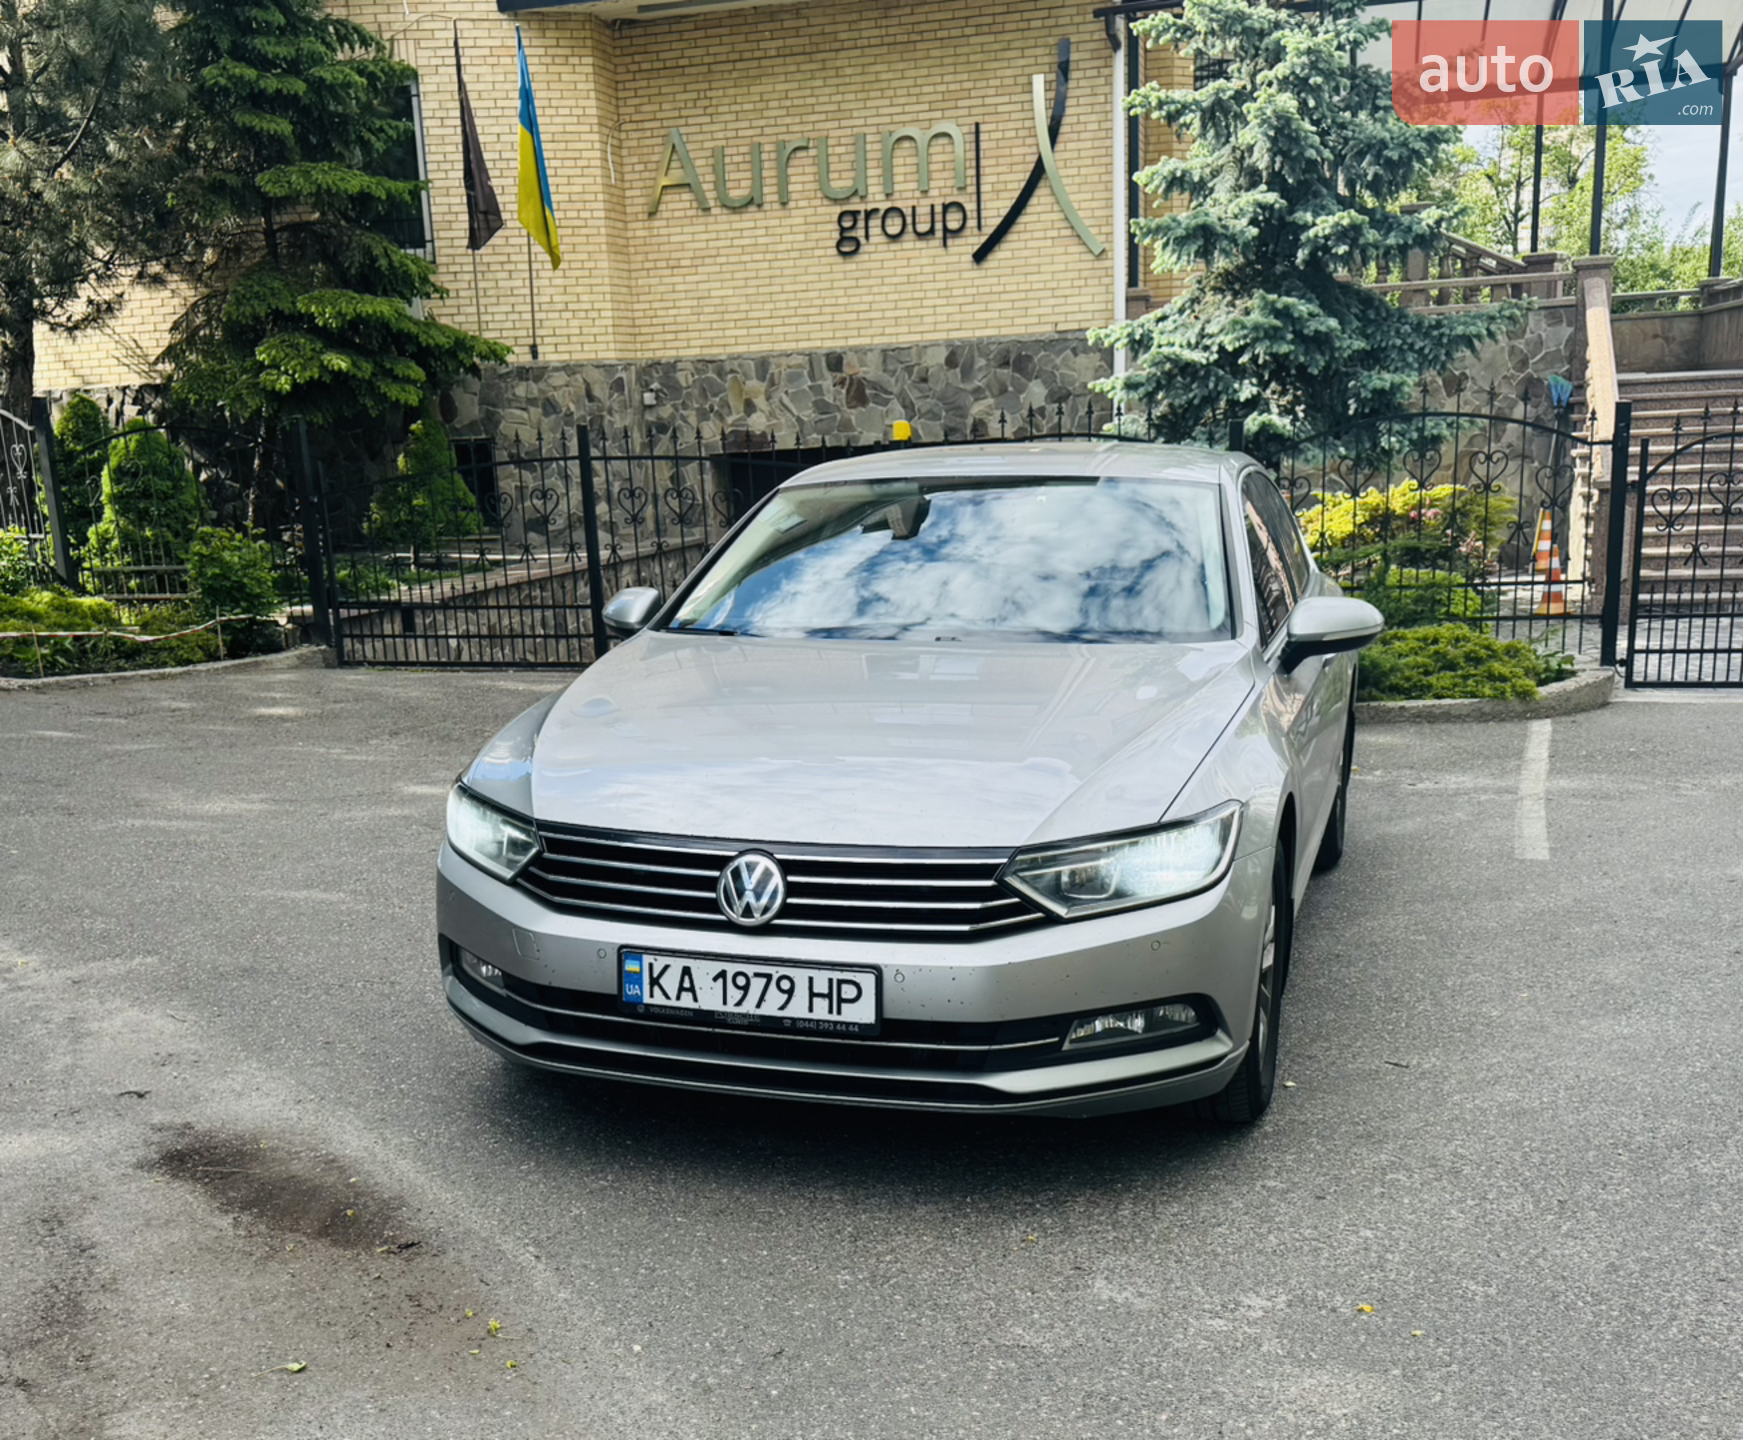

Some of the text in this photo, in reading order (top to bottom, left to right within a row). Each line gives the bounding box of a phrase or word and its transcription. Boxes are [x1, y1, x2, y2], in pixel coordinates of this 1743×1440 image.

[647, 122, 967, 216] Aurum
[835, 200, 968, 257] group
[625, 984, 641, 996] UA
[648, 962, 863, 1016] KA 1979 HP
[648, 1006, 694, 1017] VOLKSWAGEN
